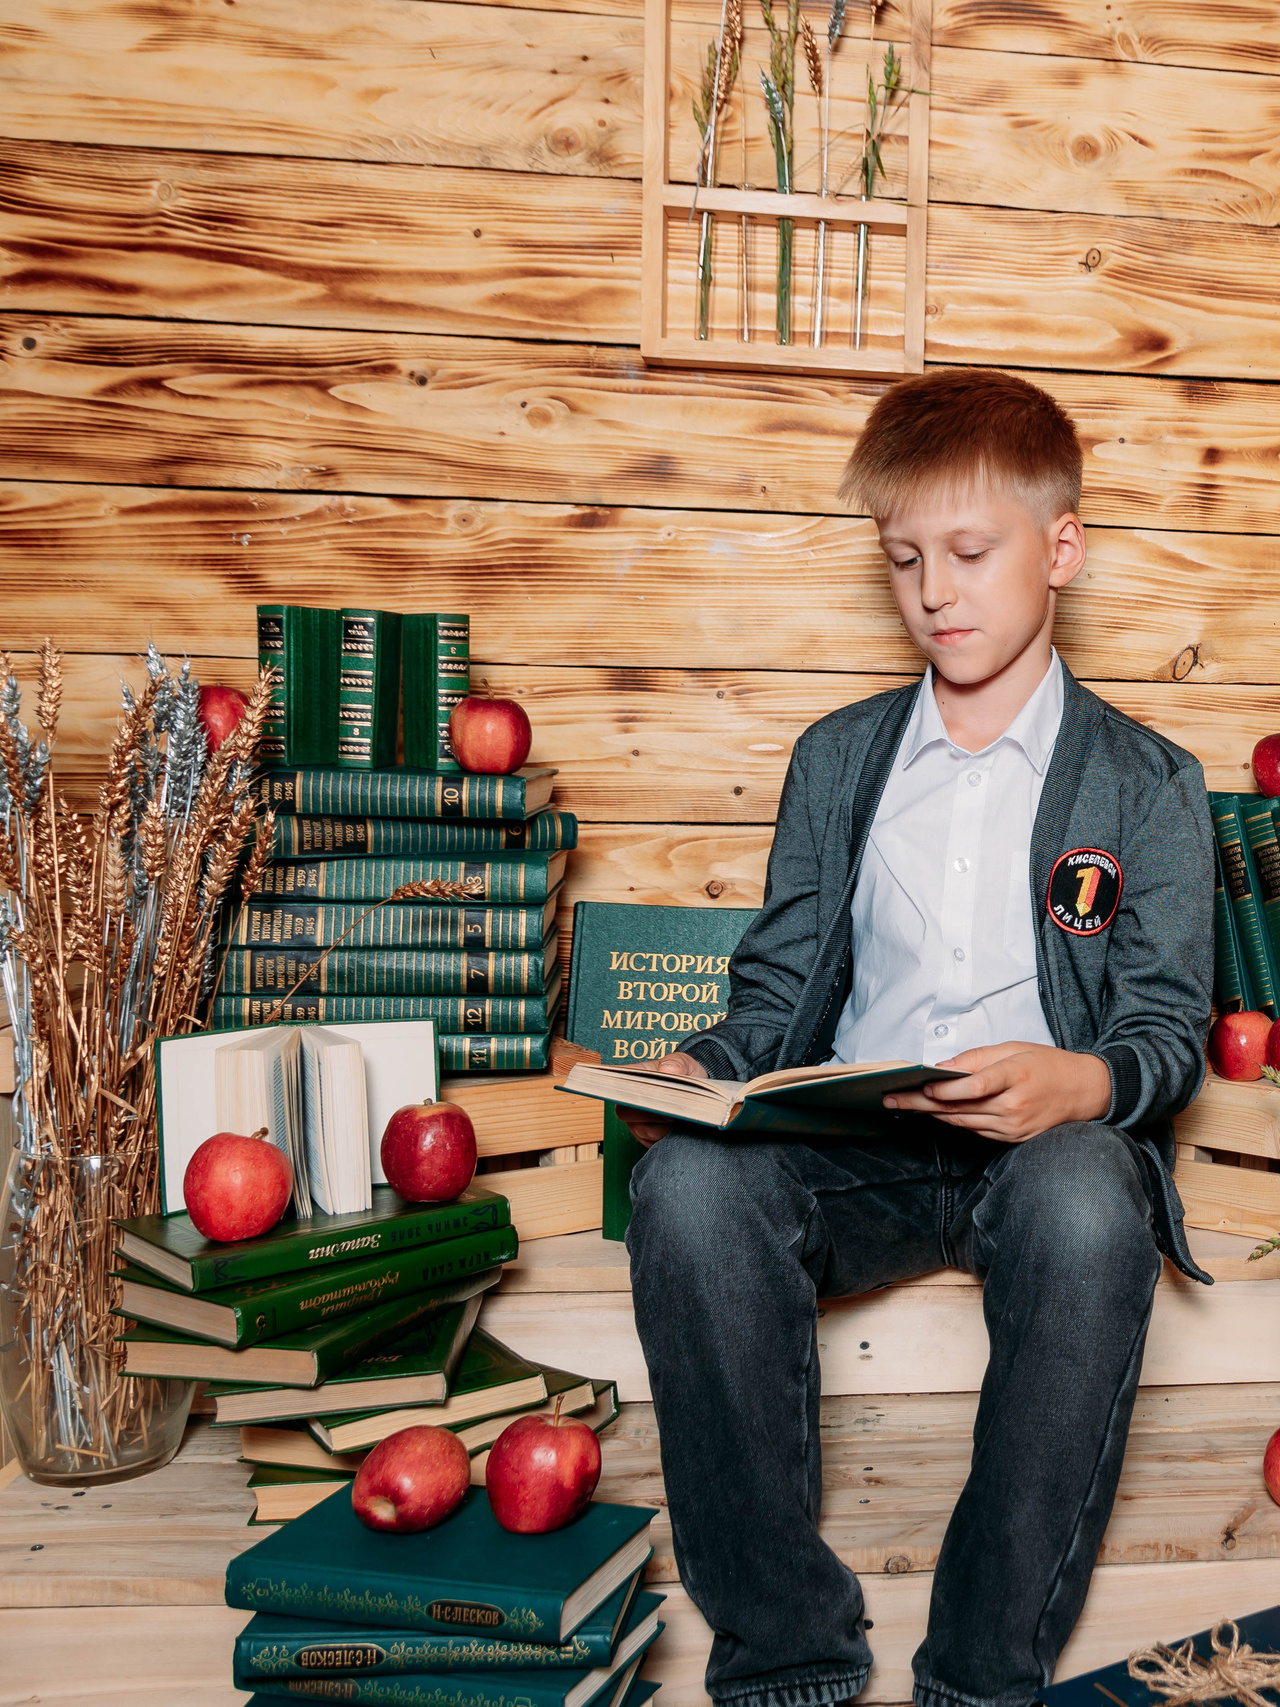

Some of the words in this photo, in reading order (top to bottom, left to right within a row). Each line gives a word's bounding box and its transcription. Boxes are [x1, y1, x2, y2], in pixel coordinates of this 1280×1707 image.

[273, 782, 282, 801] 1939
[285, 782, 294, 801] 1945
[445, 787, 459, 806] 10
[345, 824, 354, 842] 1939
[356, 823, 365, 842] 1945
[508, 825, 522, 836] 6
[297, 869, 306, 887] 1939
[308, 869, 317, 887] 1945
[1075, 866, 1101, 917] 1
[251, 911, 261, 942] ИСТОРИЯ
[262, 913, 271, 940] ВТОРОЙ
[272, 909, 283, 943] МИРОВОЙ
[283, 914, 293, 939] ВОЙНЫ
[295, 917, 304, 935] 1939
[306, 917, 315, 936] 1945
[1053, 904, 1102, 930] ЛИЦЕЙ
[467, 924, 482, 934] 5
[256, 957, 264, 988] ИСТОРИЯ
[266, 959, 275, 986] ВТОРОЙ
[277, 955, 286, 989] МИРОВОЙ
[609, 951, 731, 975] ИСТОРИЯ
[470, 969, 485, 980] 7
[616, 981, 720, 1004] ВТОРОЙ
[467, 1007, 482, 1025] 12
[471, 1048, 487, 1064] 11
[427, 1216, 468, 1233] ЭМИЛЬ
[390, 1228, 421, 1242] ЗОЛЯ
[308, 1233, 382, 1260] Западня
[299, 1270, 400, 1311] Рудольштадт
